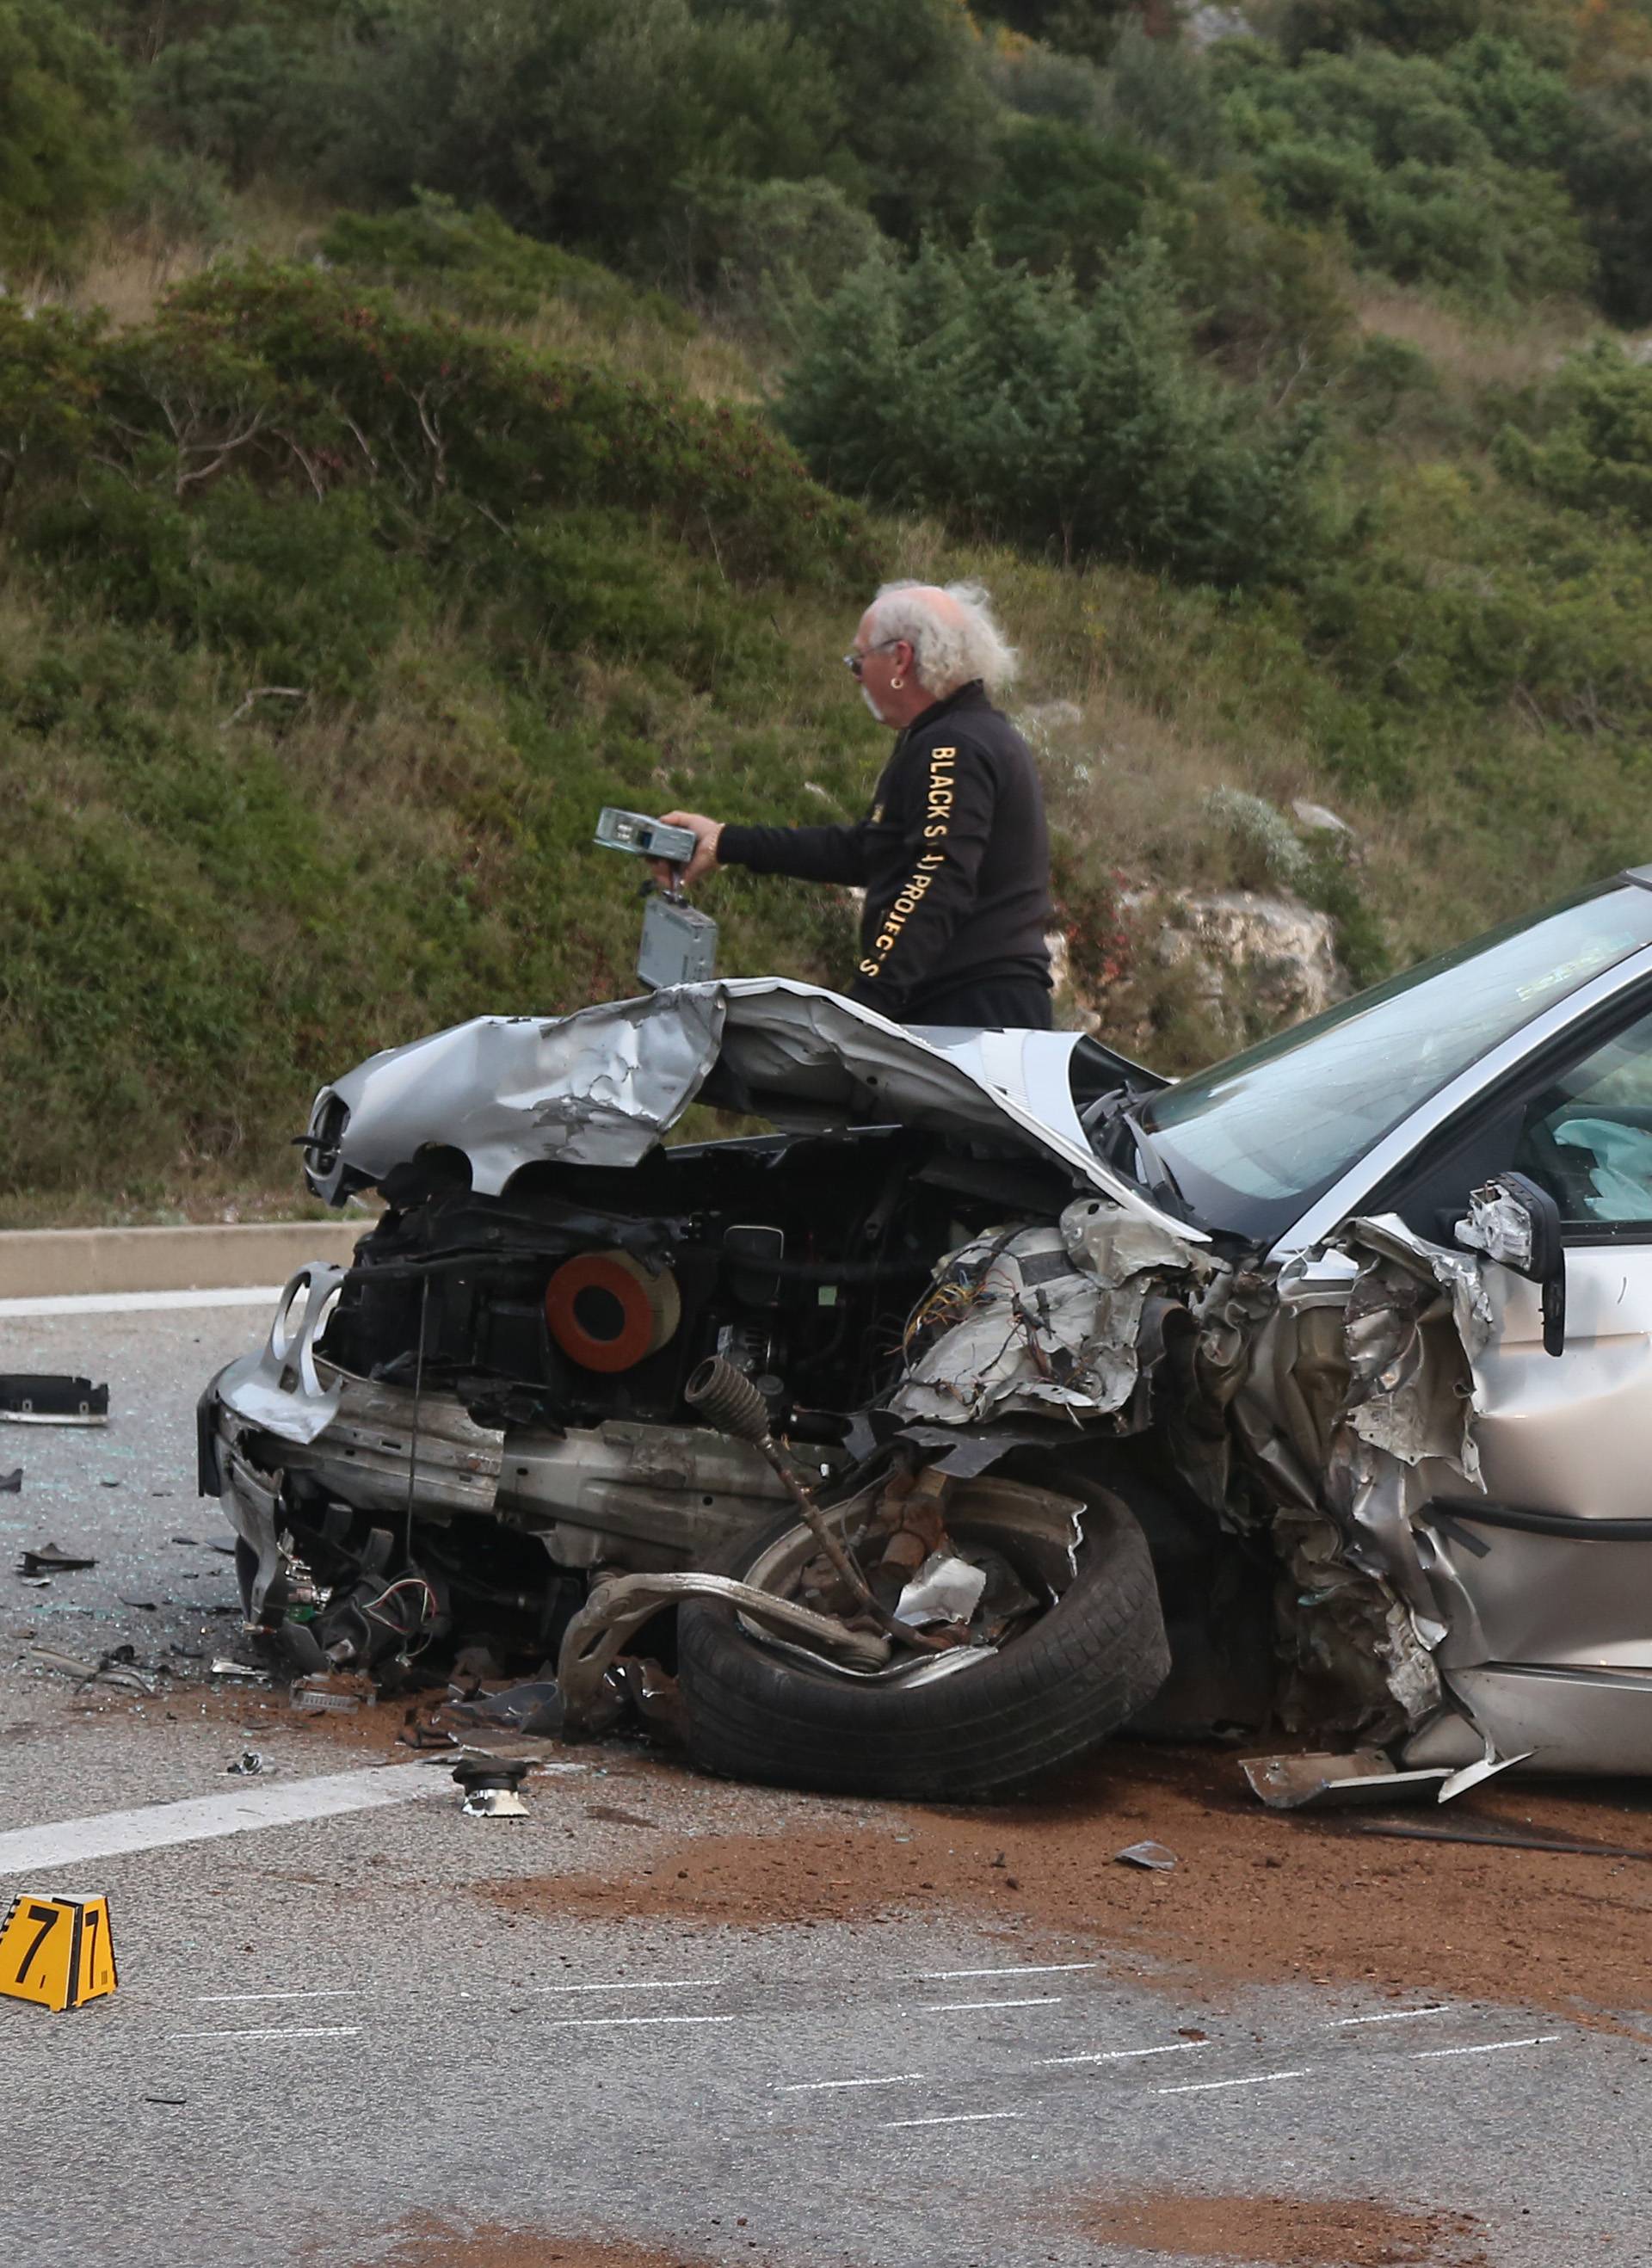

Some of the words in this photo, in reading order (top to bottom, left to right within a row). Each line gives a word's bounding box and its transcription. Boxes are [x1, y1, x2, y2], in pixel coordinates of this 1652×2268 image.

[927, 747, 956, 819] BLACK
[15, 1905, 59, 1984] 7
[85, 1909, 99, 1989] 7
